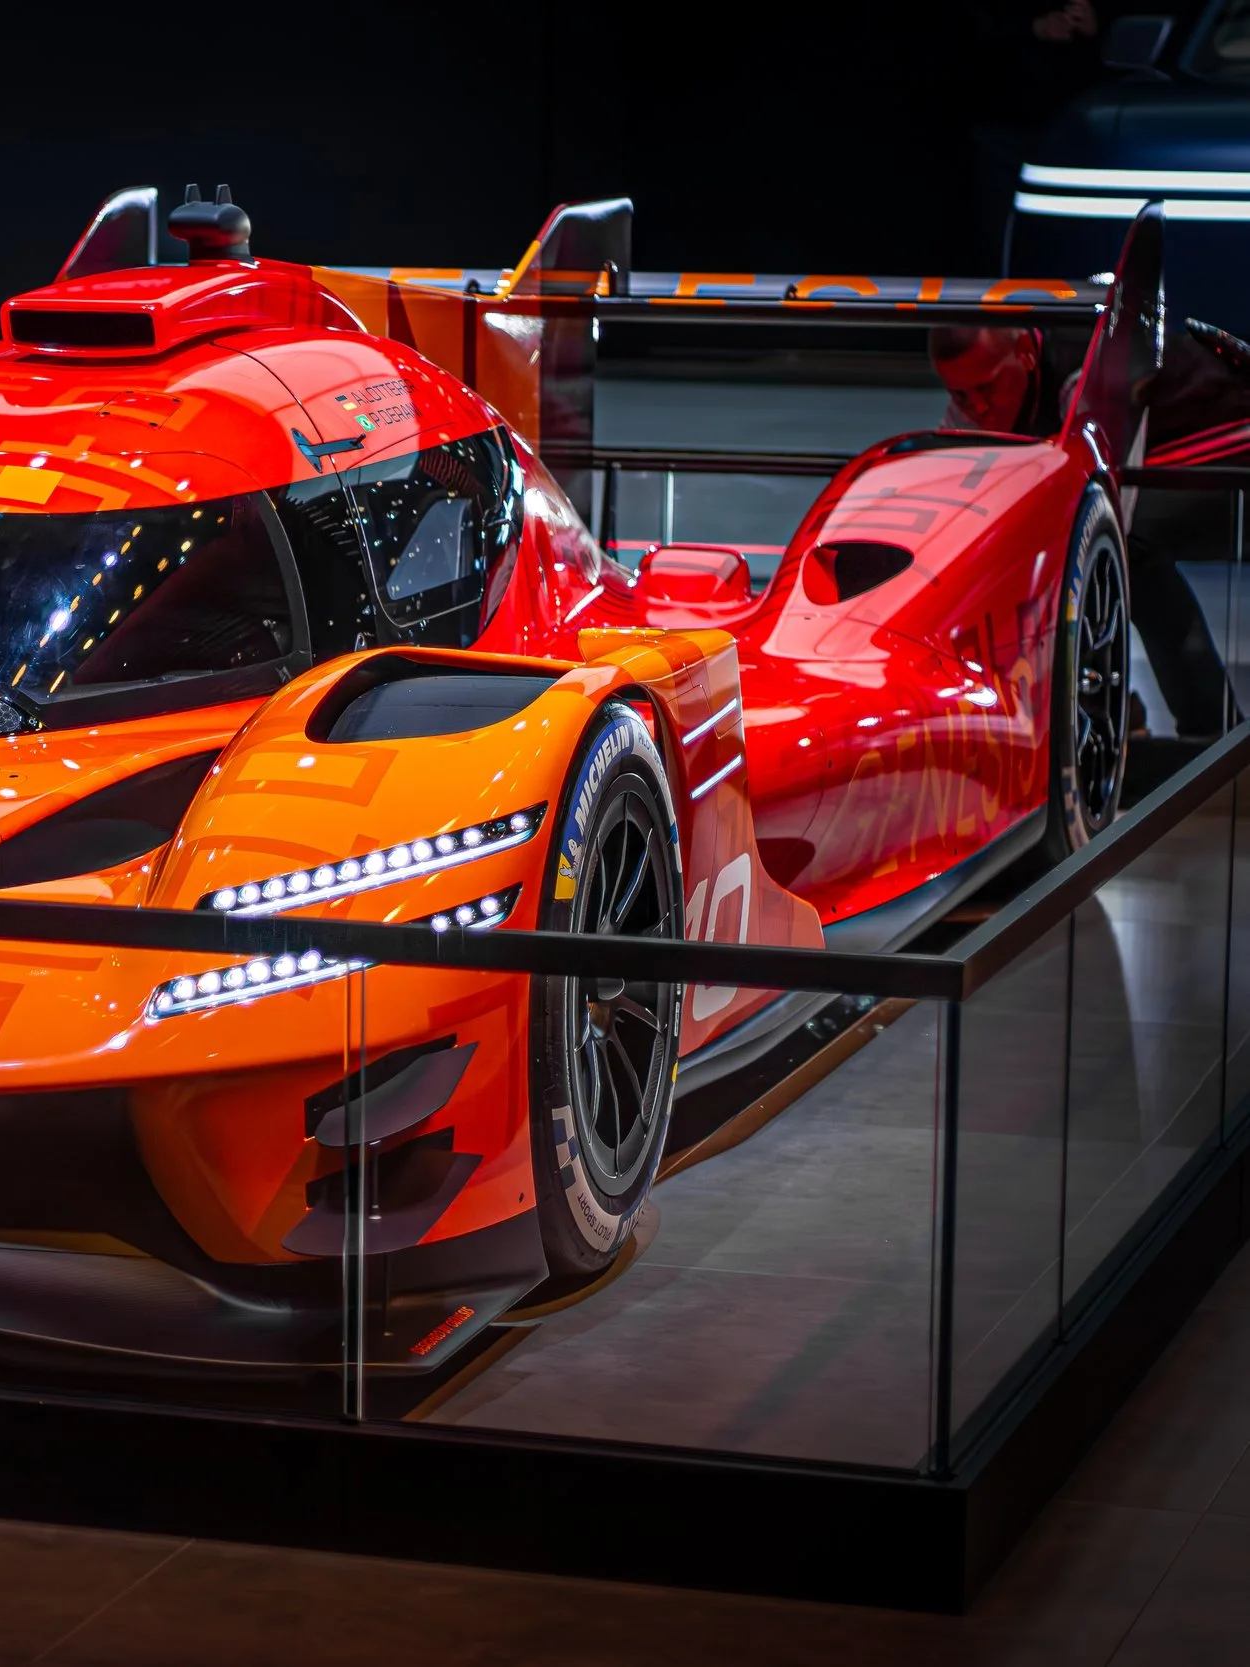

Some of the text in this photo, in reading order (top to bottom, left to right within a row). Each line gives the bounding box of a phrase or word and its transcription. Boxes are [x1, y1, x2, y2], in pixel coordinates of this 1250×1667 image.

[575, 724, 630, 836] MICHELIN
[577, 1192, 612, 1241] PILOT SPORT
